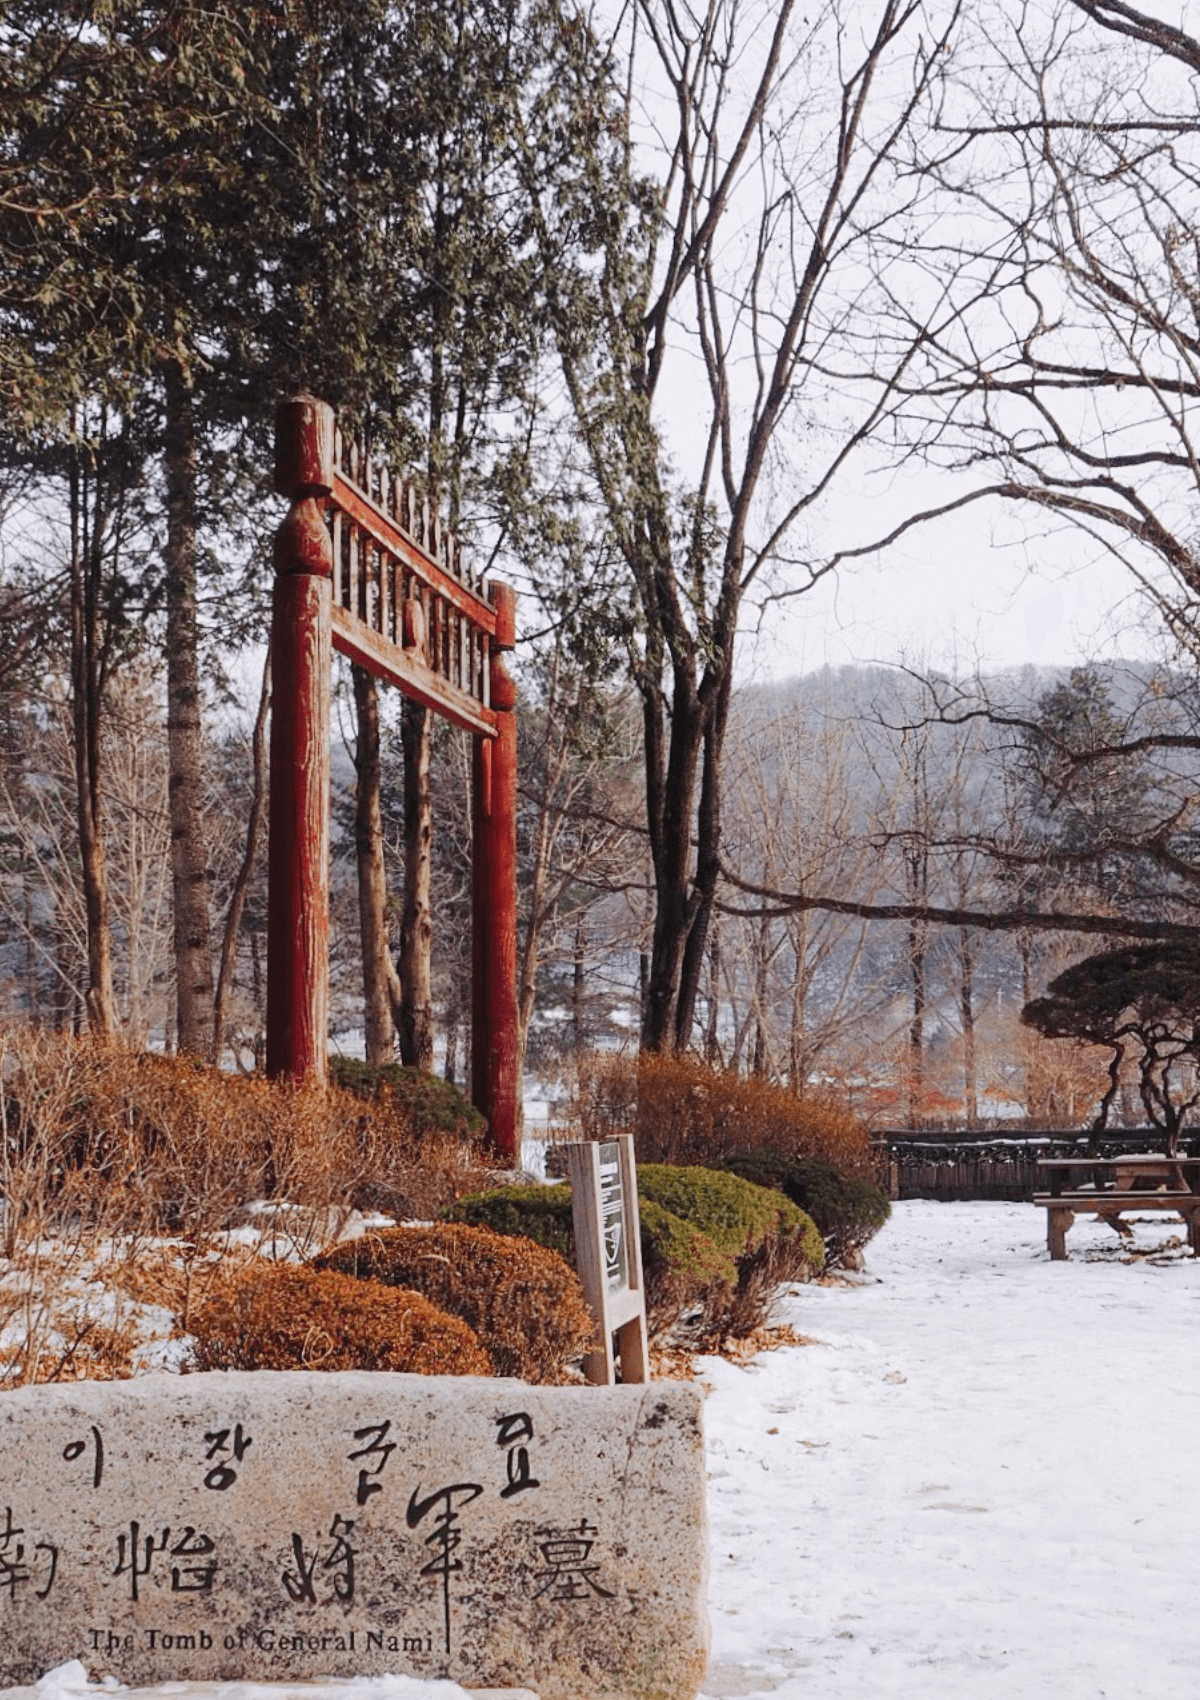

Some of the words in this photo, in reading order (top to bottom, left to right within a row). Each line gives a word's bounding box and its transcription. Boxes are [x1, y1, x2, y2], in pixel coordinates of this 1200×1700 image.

[88, 1629, 135, 1651] The
[145, 1629, 213, 1651] Tomb
[223, 1629, 249, 1651] of
[256, 1629, 355, 1652] General
[365, 1629, 433, 1652] Nami
